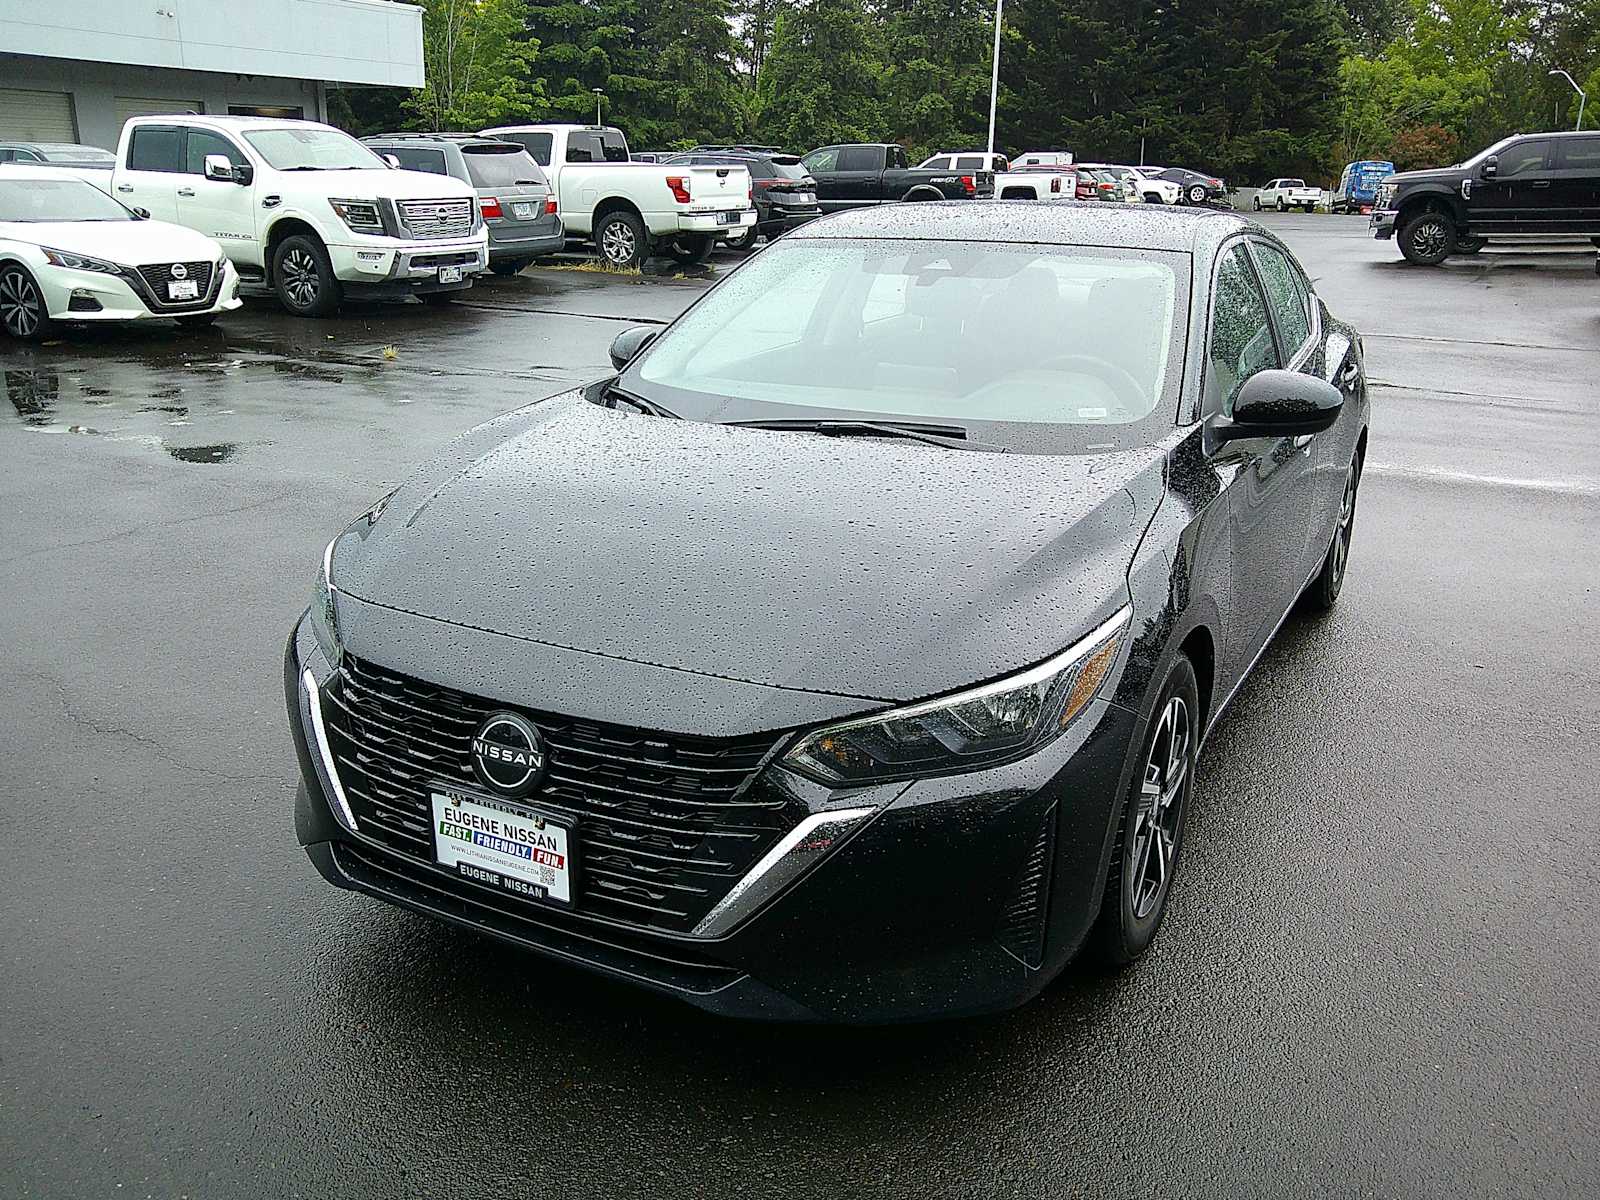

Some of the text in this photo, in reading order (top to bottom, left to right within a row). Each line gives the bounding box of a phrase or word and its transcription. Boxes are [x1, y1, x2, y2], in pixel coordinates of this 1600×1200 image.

[473, 740, 542, 768] NISSAN
[443, 823, 562, 869] FAST. FRIENDLY. FUN.
[444, 807, 557, 851] EUGENE NISSAN
[459, 864, 543, 899] EUGENE NISSAN
